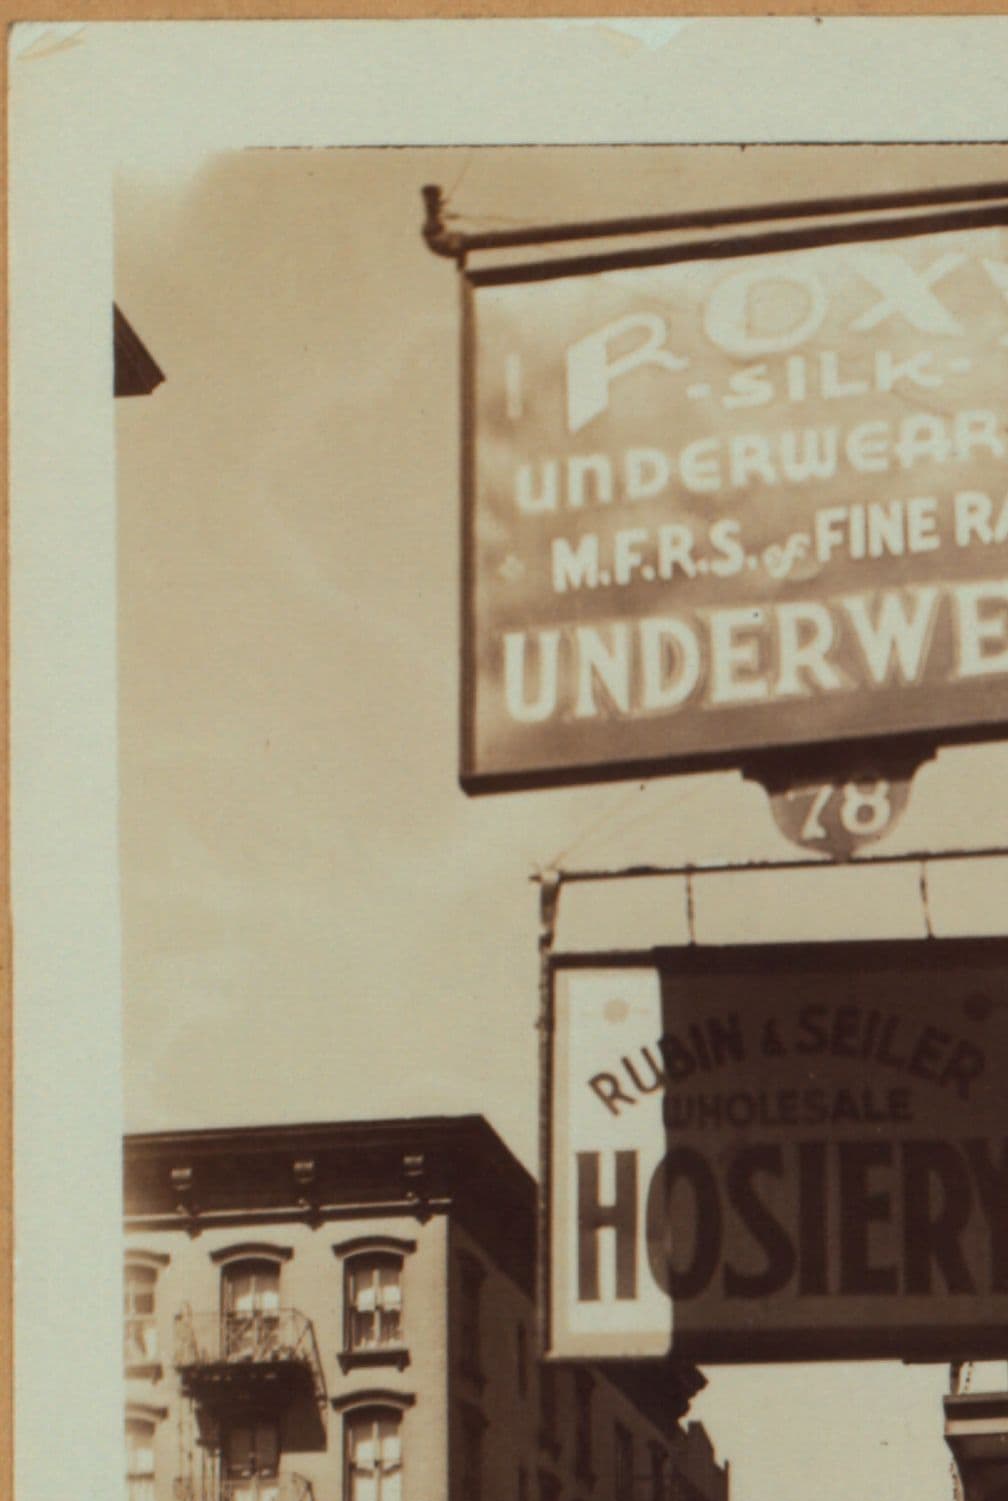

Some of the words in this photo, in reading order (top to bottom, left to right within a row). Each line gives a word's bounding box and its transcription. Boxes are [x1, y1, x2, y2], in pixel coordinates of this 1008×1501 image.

[551, 518, 758, 593] M.F.R.S.
[762, 533, 813, 579] of
[815, 496, 940, 562] FINE
[786, 780, 891, 841] 78
[588, 1012, 746, 1116] RUBIN
[760, 1018, 788, 1056] &
[795, 1005, 987, 1099] SEILER
[664, 1087, 914, 1131] WHOLESALE
